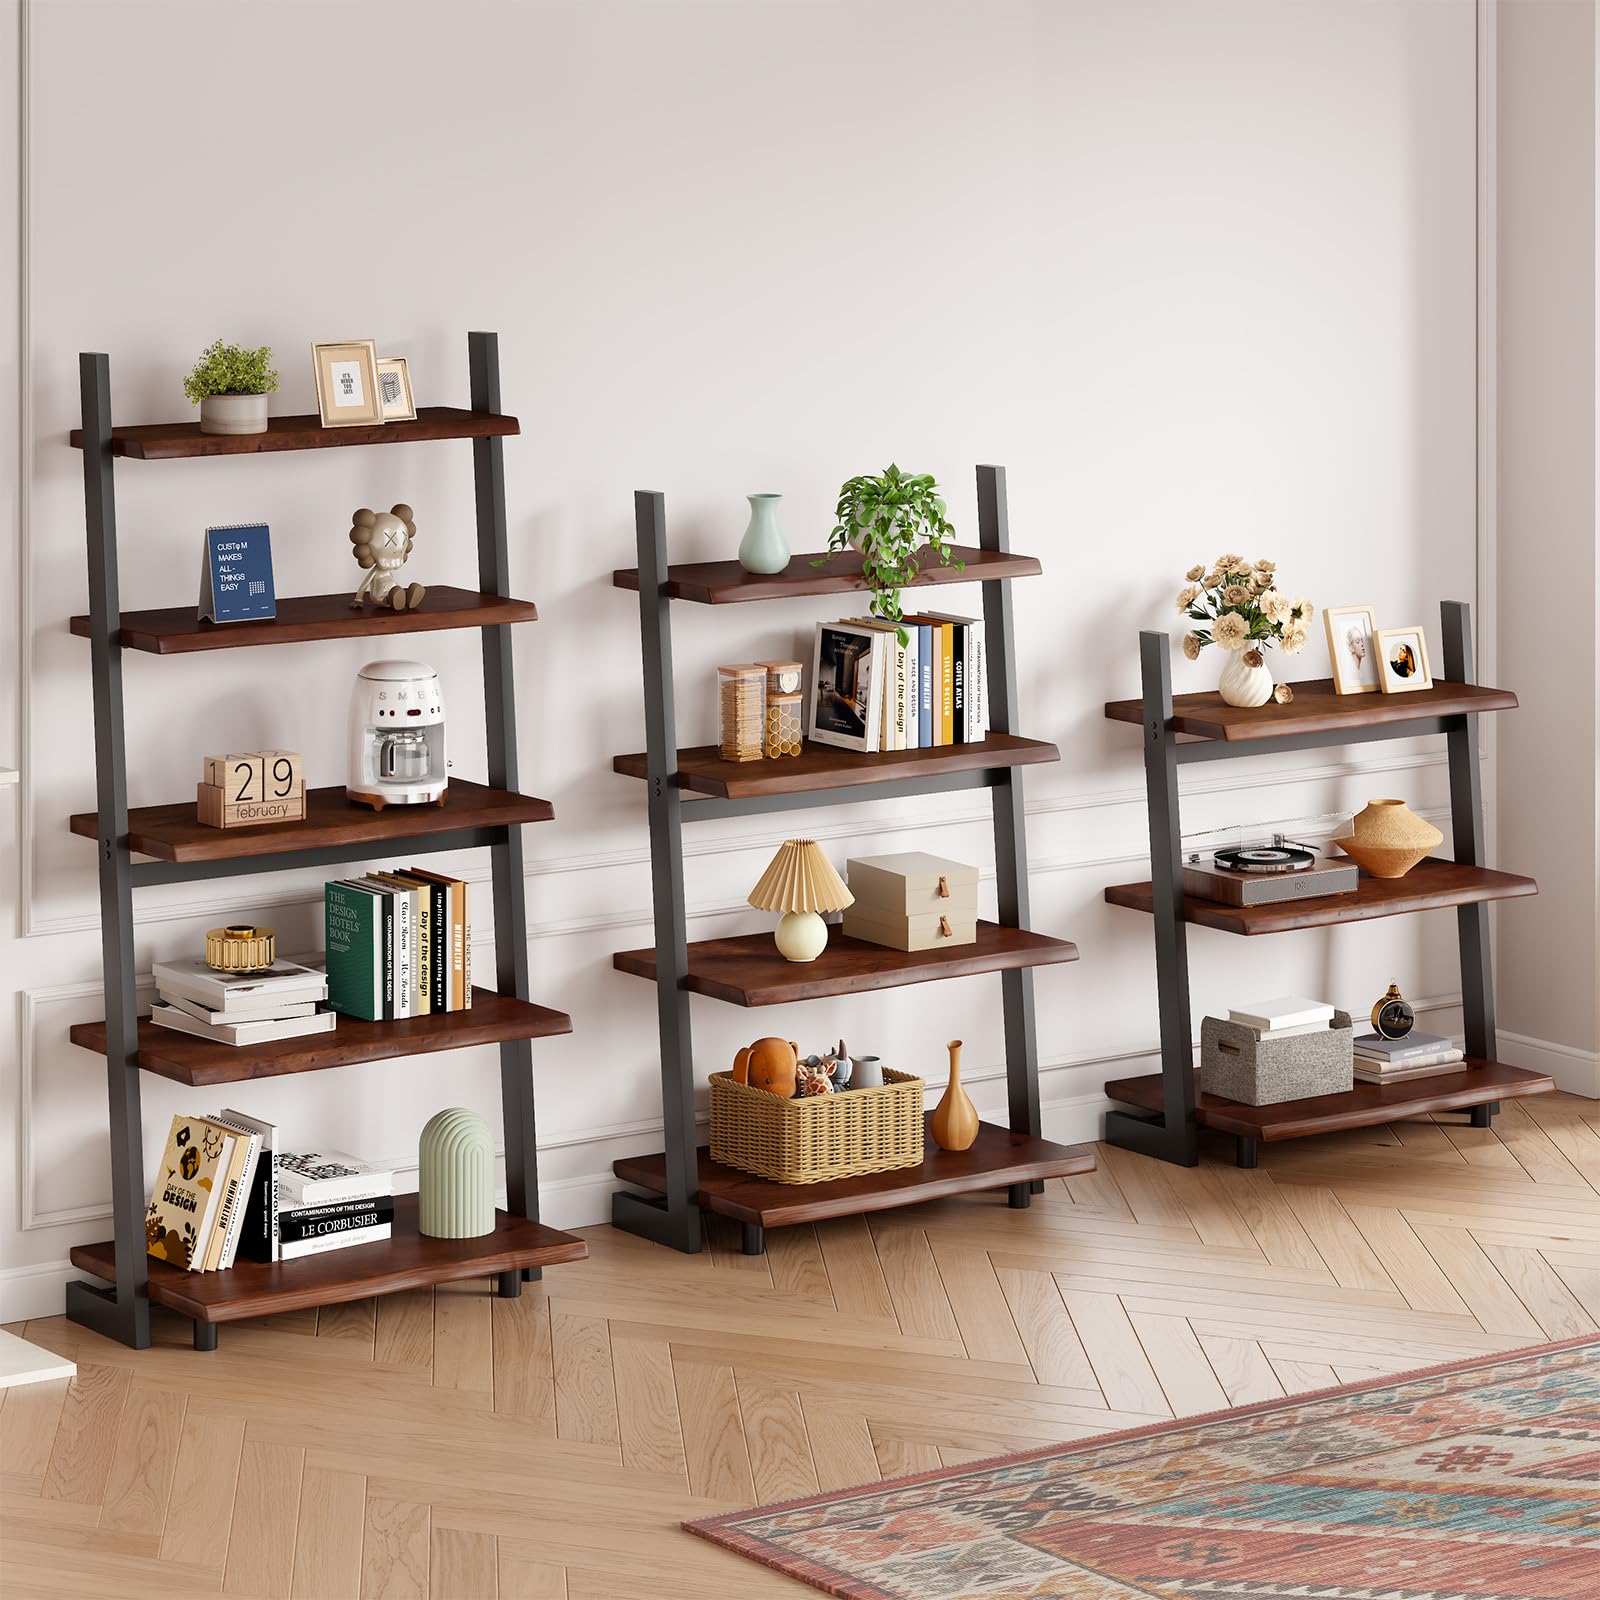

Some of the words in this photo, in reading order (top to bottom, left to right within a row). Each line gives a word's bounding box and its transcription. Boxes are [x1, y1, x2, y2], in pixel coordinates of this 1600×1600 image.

[219, 553, 242, 562] MAKES
[220, 573, 245, 582] THINGS
[221, 583, 239, 591] EASY
[898, 672, 904, 682] of
[236, 804, 288, 819] february
[329, 891, 345, 904] THE
[330, 903, 357, 919] DESIGN
[330, 915, 360, 932] HOTELS
[420, 911, 429, 930] Day
[330, 928, 350, 942] BOOK
[422, 933, 429, 943] of
[420, 964, 429, 996] design
[438, 983, 442, 993] we
[167, 1183, 178, 1192] DAY
[186, 1191, 196, 1200] THE
[163, 1190, 197, 1213] DESIGN
[219, 1178, 238, 1230] MINIMALISM
[291, 1207, 335, 1218] CONTAMINATION
[302, 1224, 315, 1237] LE
[317, 1213, 377, 1234] CORBUSIER
